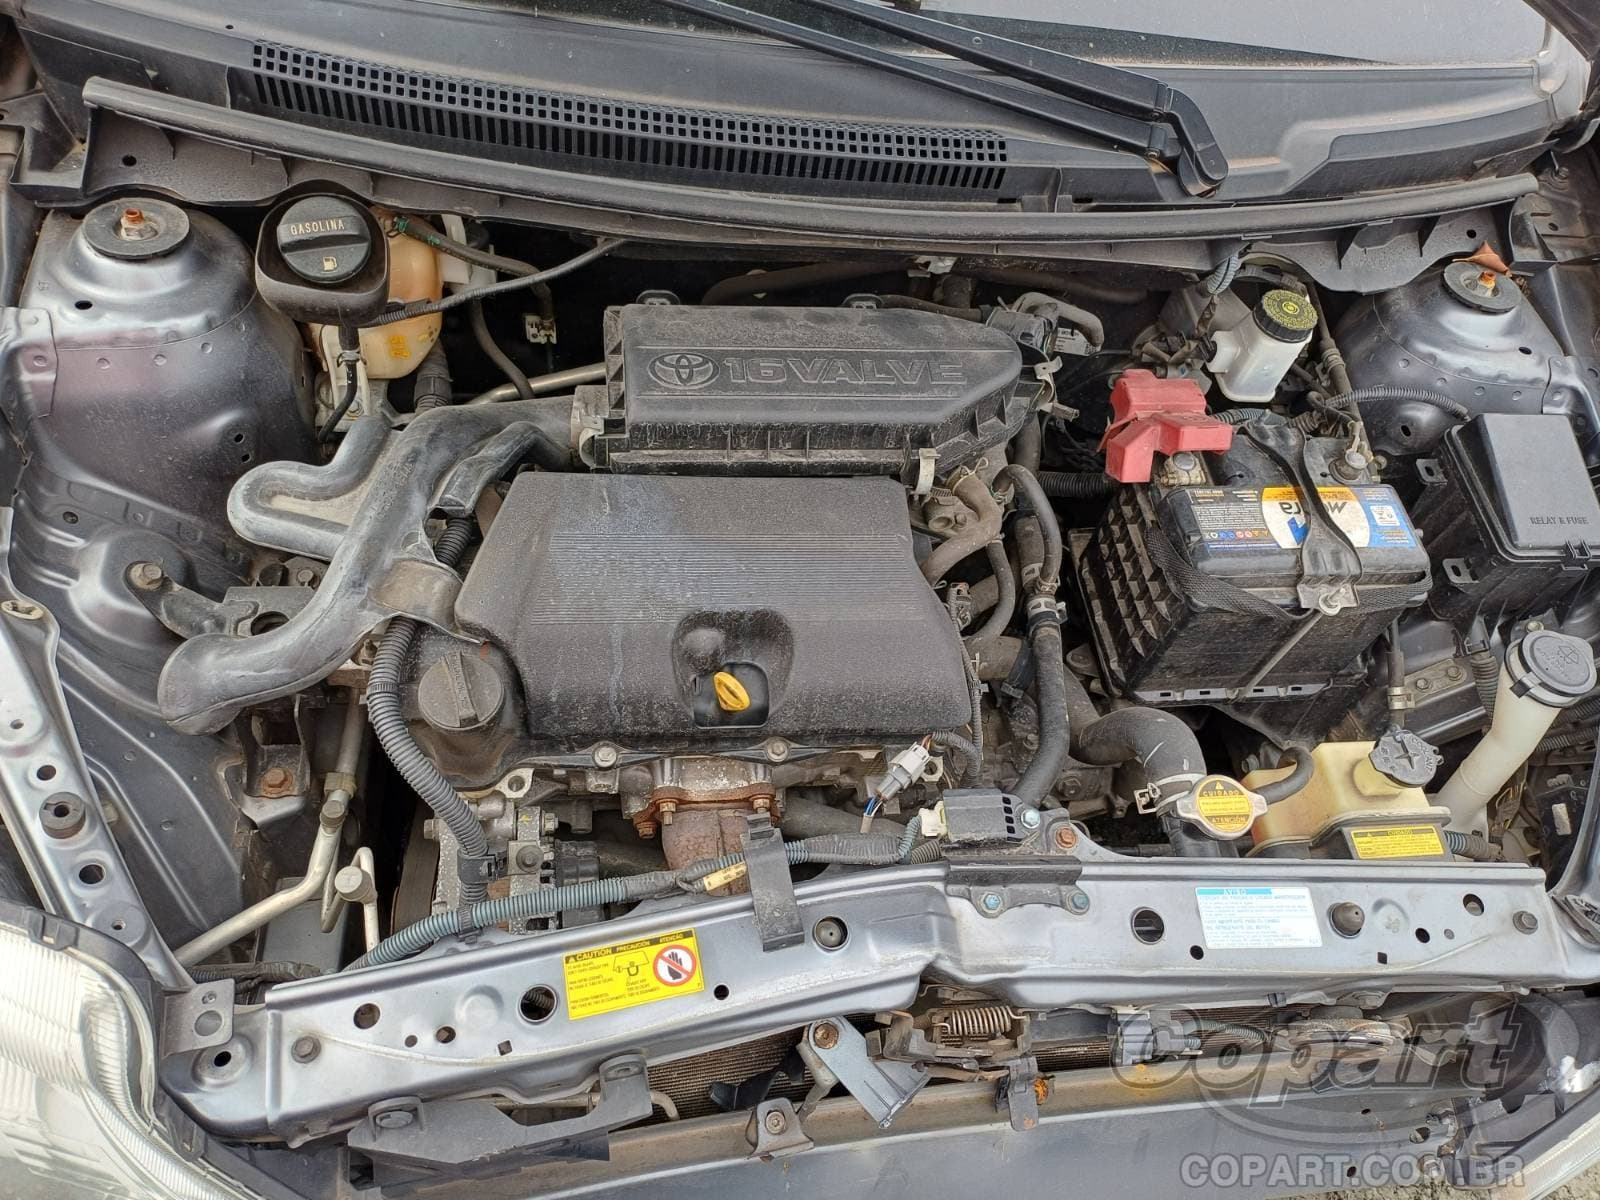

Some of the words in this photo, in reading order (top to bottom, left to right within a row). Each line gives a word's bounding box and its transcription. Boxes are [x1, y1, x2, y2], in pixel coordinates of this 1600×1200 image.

[290, 219, 345, 236] GASOLINA
[1529, 516, 1557, 525] RELAY
[1566, 516, 1589, 525] FUSE
[1202, 789, 1241, 798] CUIDADO
[576, 948, 613, 961] CAUTION
